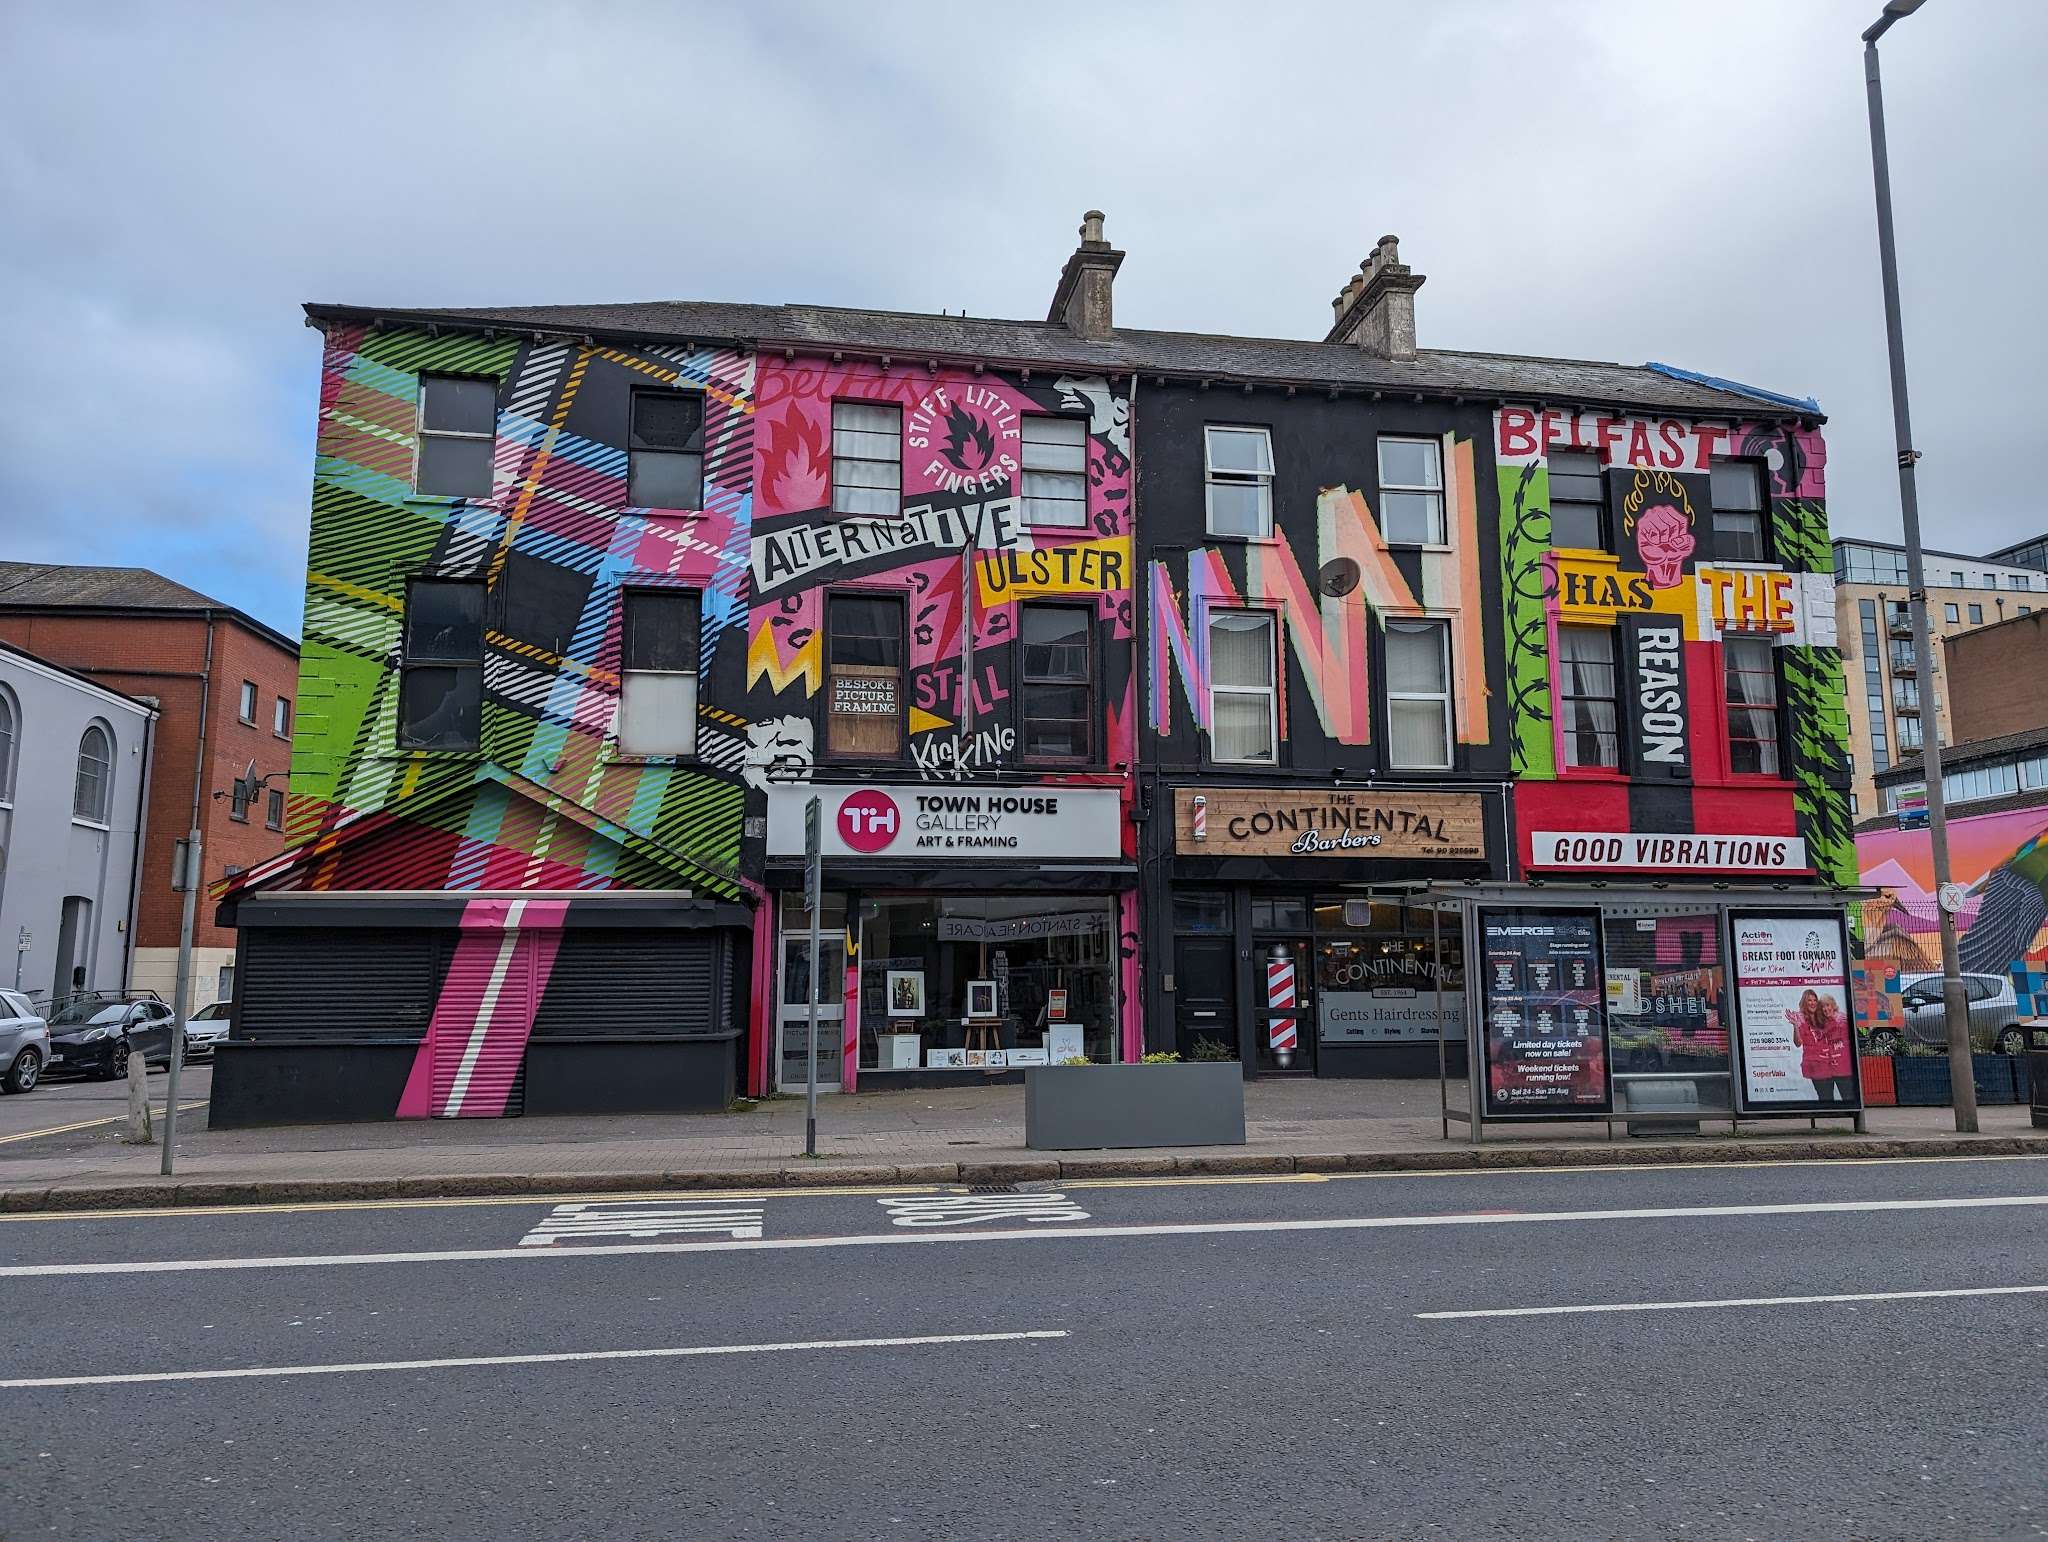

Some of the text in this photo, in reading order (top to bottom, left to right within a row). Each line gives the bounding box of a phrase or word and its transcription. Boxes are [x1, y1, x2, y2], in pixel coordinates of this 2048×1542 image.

[908, 385, 1020, 449] STIFF LITTLE
[1499, 407, 1728, 469] BELFAST
[923, 453, 1018, 496] FINGERS
[982, 547, 1122, 592] ULSTER
[1564, 573, 1654, 609] HAS
[1700, 568, 1795, 633] THE
[836, 679, 895, 690] BESPOKE
[836, 691, 894, 702] PICTURE
[1638, 627, 1685, 764] REASON
[834, 703, 896, 713] FRAMING
[916, 796, 1058, 814] TOWN HOUSE
[1328, 793, 1355, 805] THE
[916, 814, 1001, 831] GALLERY
[1228, 807, 1450, 843] CONTINENTAL
[916, 836, 1018, 848] ART & FRAMING
[1290, 828, 1382, 854] Barbers
[1554, 838, 1787, 866] GOOD VIBRATIONS
[1487, 927, 1555, 936] EMERGE
[1381, 941, 1405, 952] THE
[1742, 951, 1836, 961] BREAST FOOT FORWARD
[1335, 958, 1453, 985] CONTINENTAL
[1330, 1007, 1459, 1026] Gents Hairdressng
[1513, 1041, 1541, 1049] Limited
[1542, 1041, 1555, 1049] day
[1554, 1064, 1579, 1072] tickets
[1753, 1070, 1786, 1078] SuperValu
[1526, 1073, 1571, 1082] running low!
